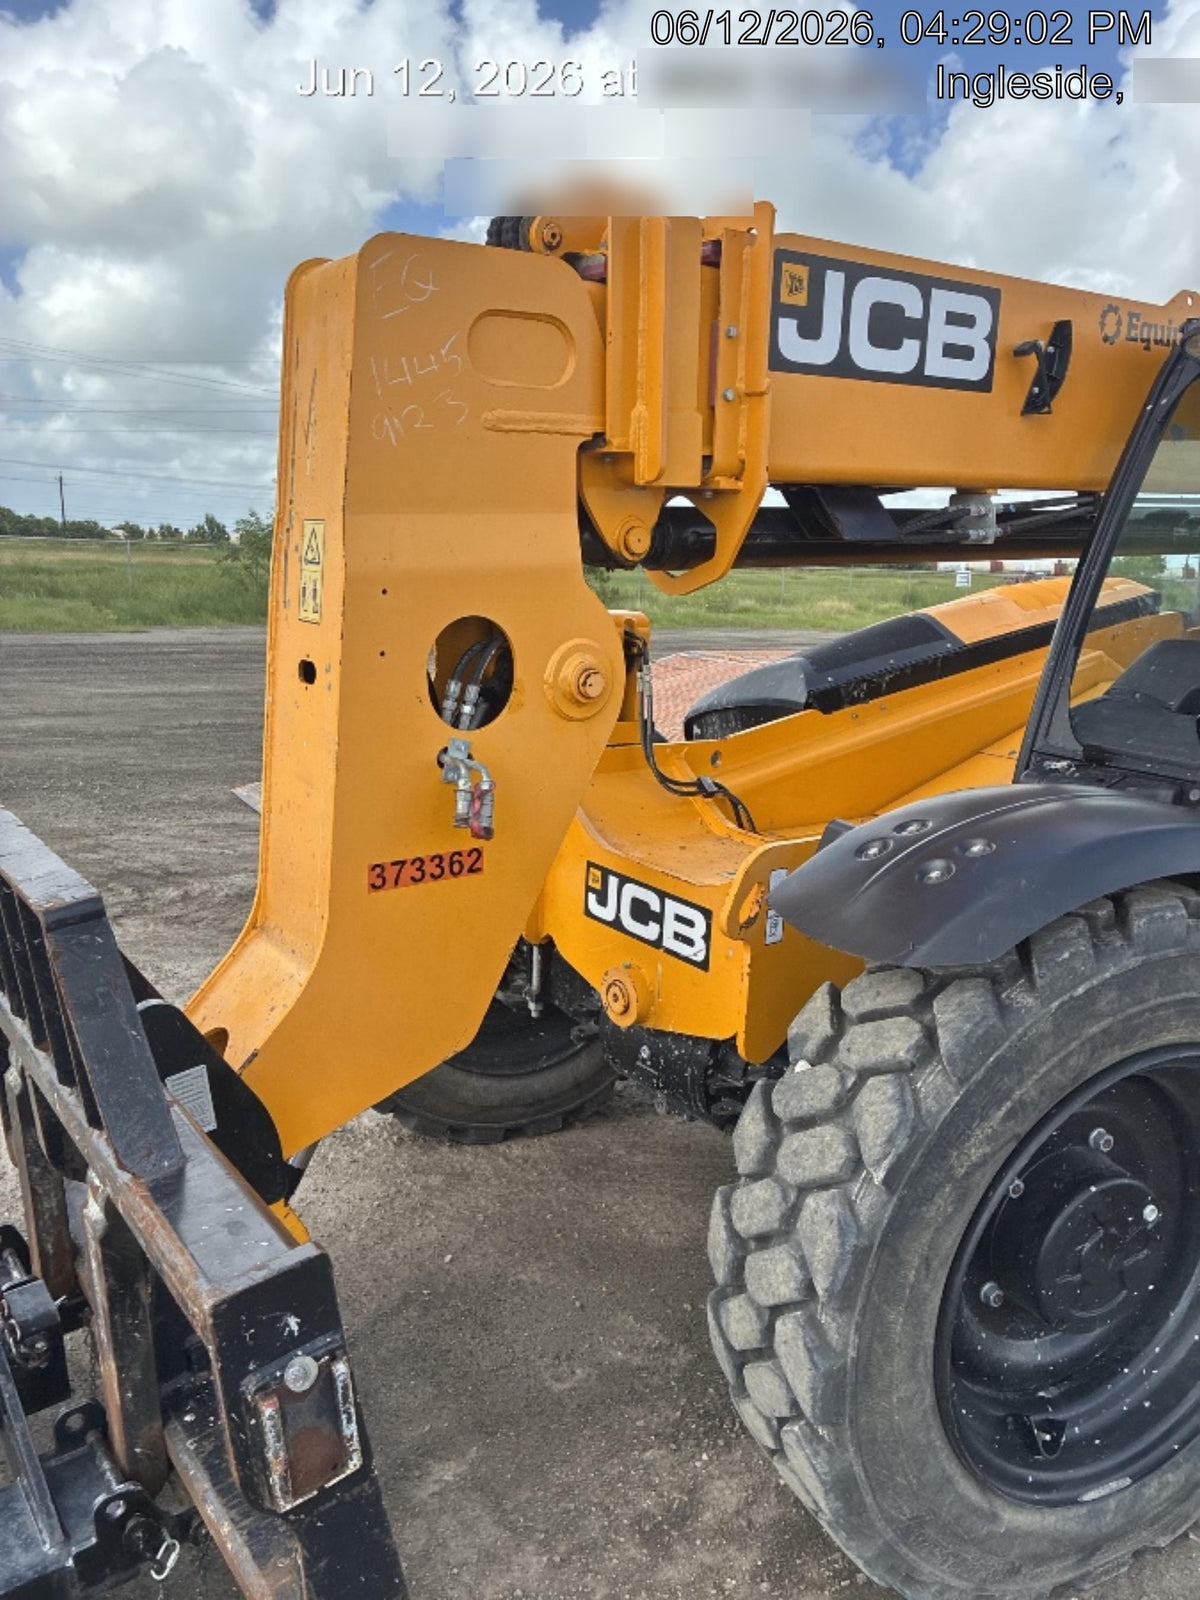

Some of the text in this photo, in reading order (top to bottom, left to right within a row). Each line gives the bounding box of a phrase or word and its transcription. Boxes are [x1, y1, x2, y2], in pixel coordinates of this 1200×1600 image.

[777, 269, 993, 382] JCB
[369, 847, 483, 891] 373362
[586, 874, 707, 963] JCB
